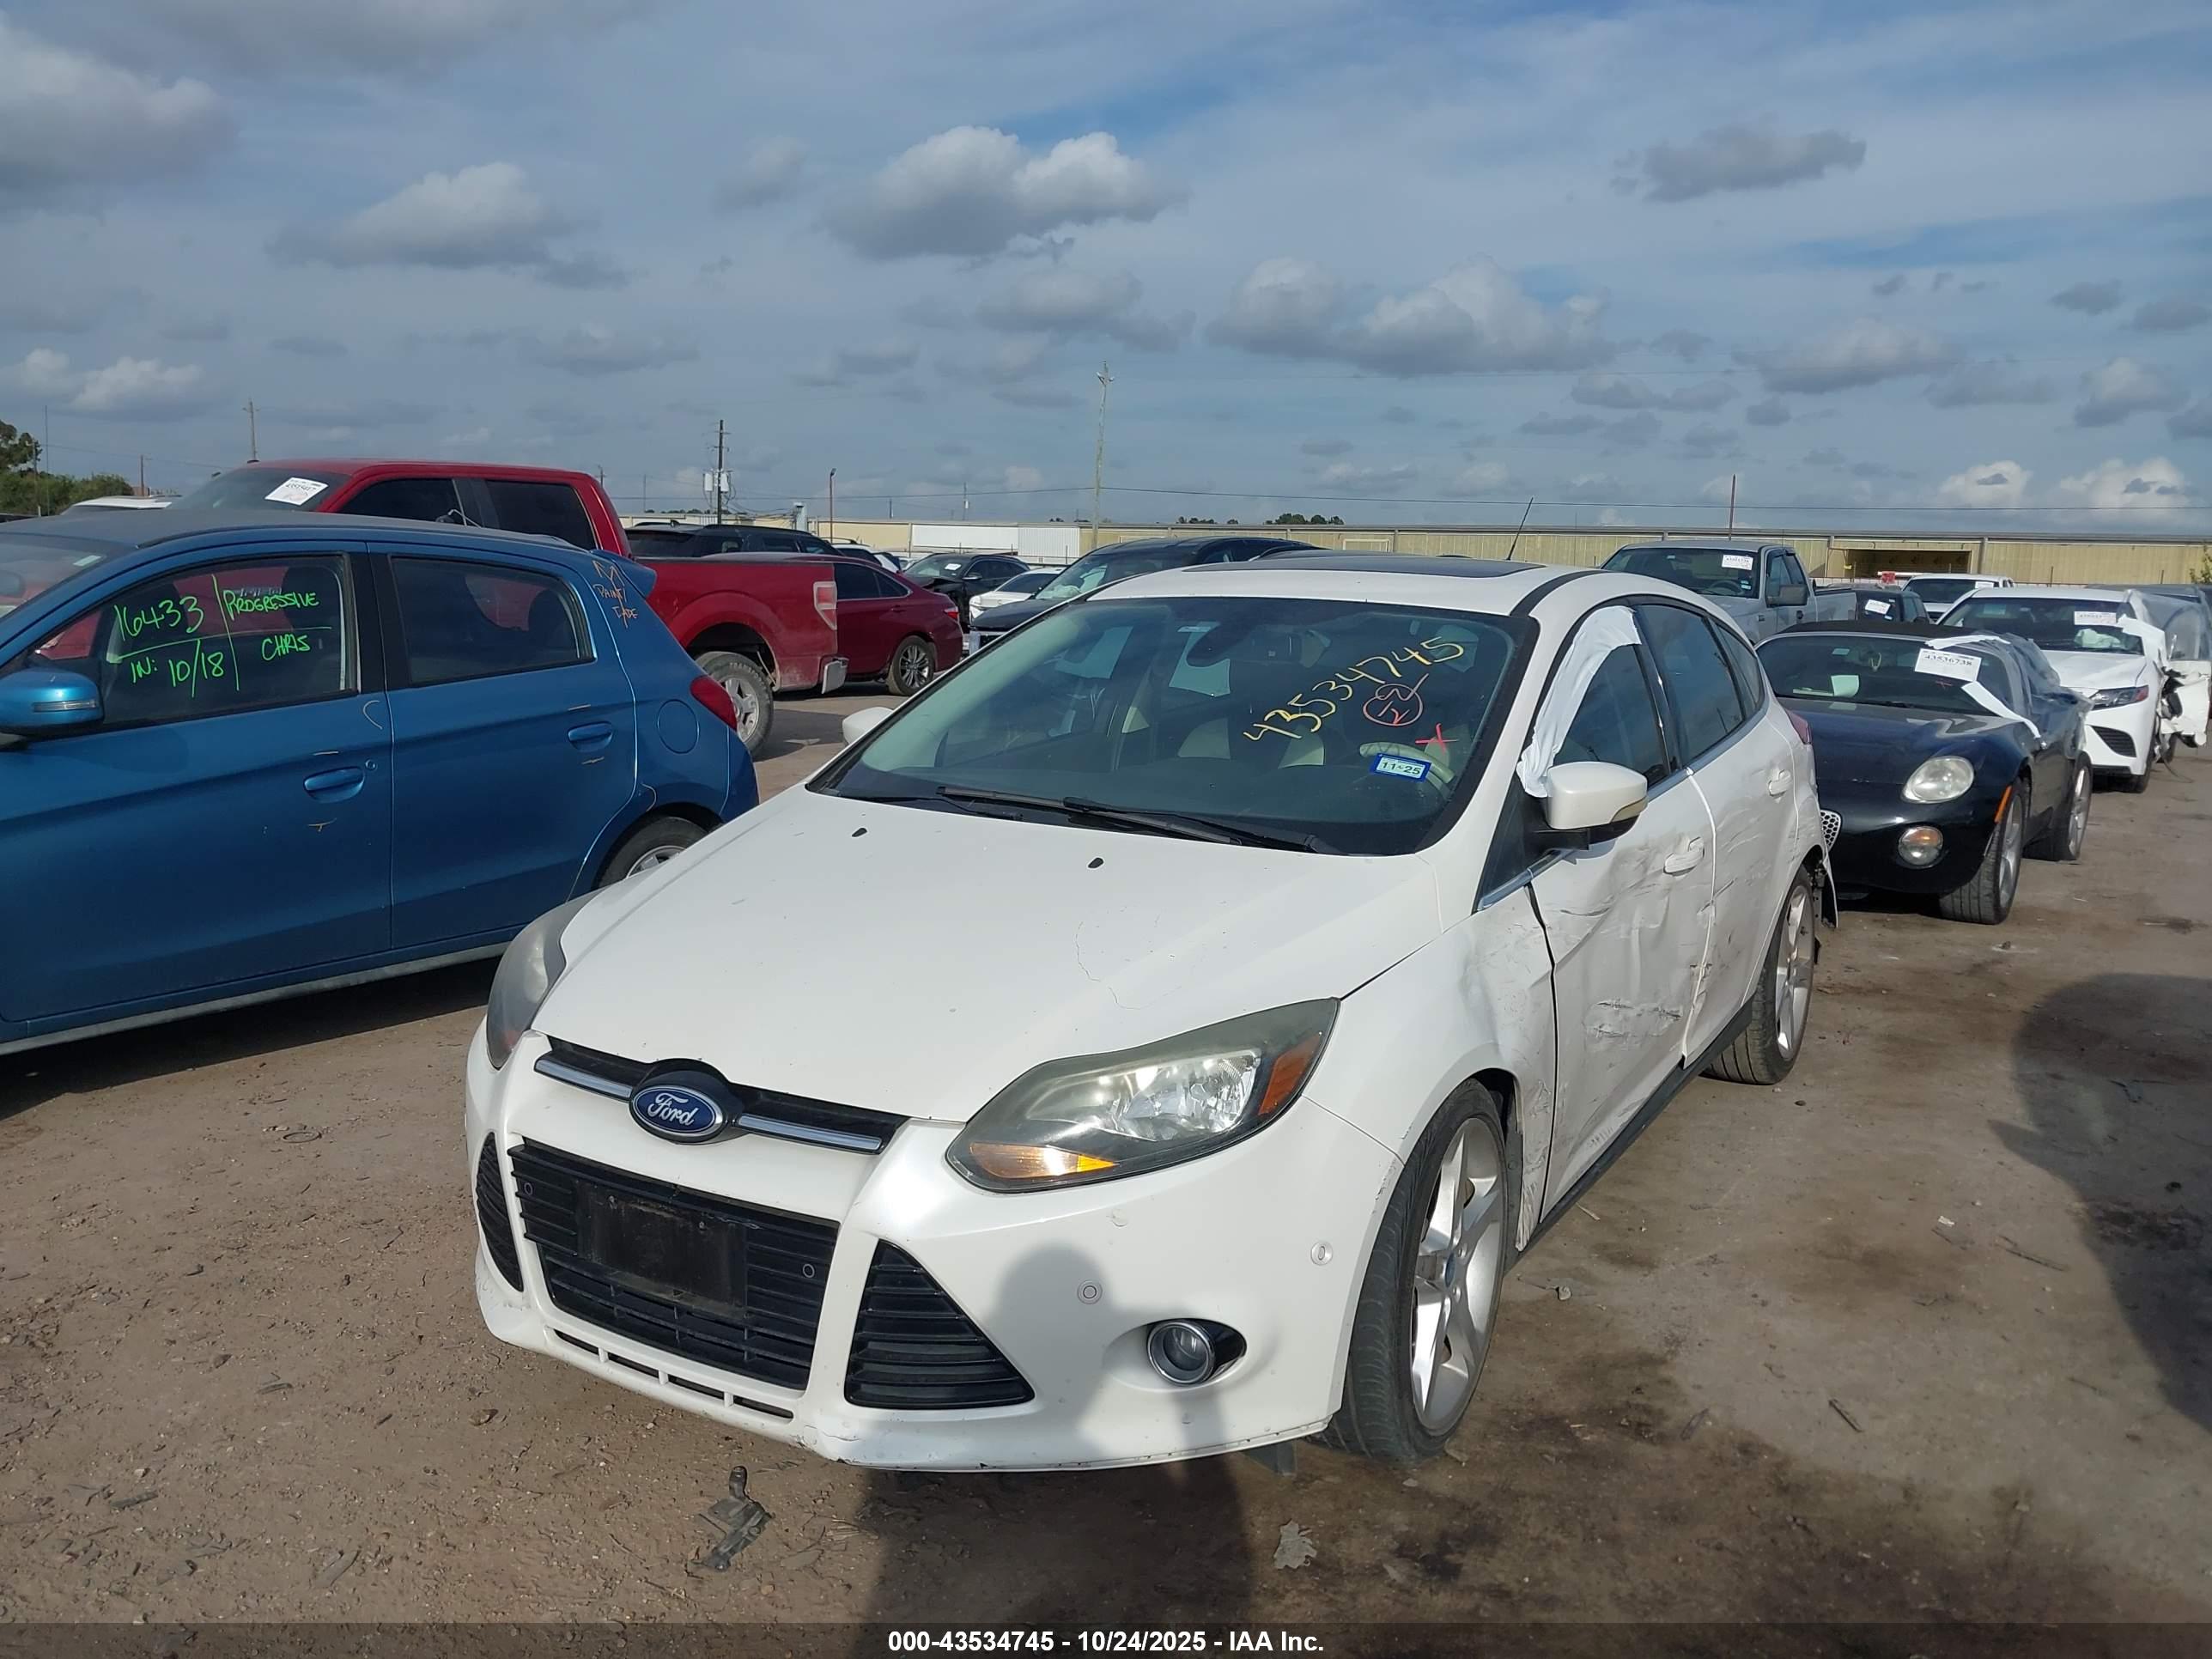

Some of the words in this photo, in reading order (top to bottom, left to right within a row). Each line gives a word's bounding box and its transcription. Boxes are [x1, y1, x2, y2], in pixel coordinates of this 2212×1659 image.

[114, 596, 204, 641] 16433
[222, 590, 320, 621] PROGRESSIVE
[261, 633, 312, 661] CHRIS
[131, 656, 159, 684] IN:
[167, 638, 225, 698] 10/18
[1243, 635, 1465, 741] 43534745
[647, 1092, 700, 1126] Ford
